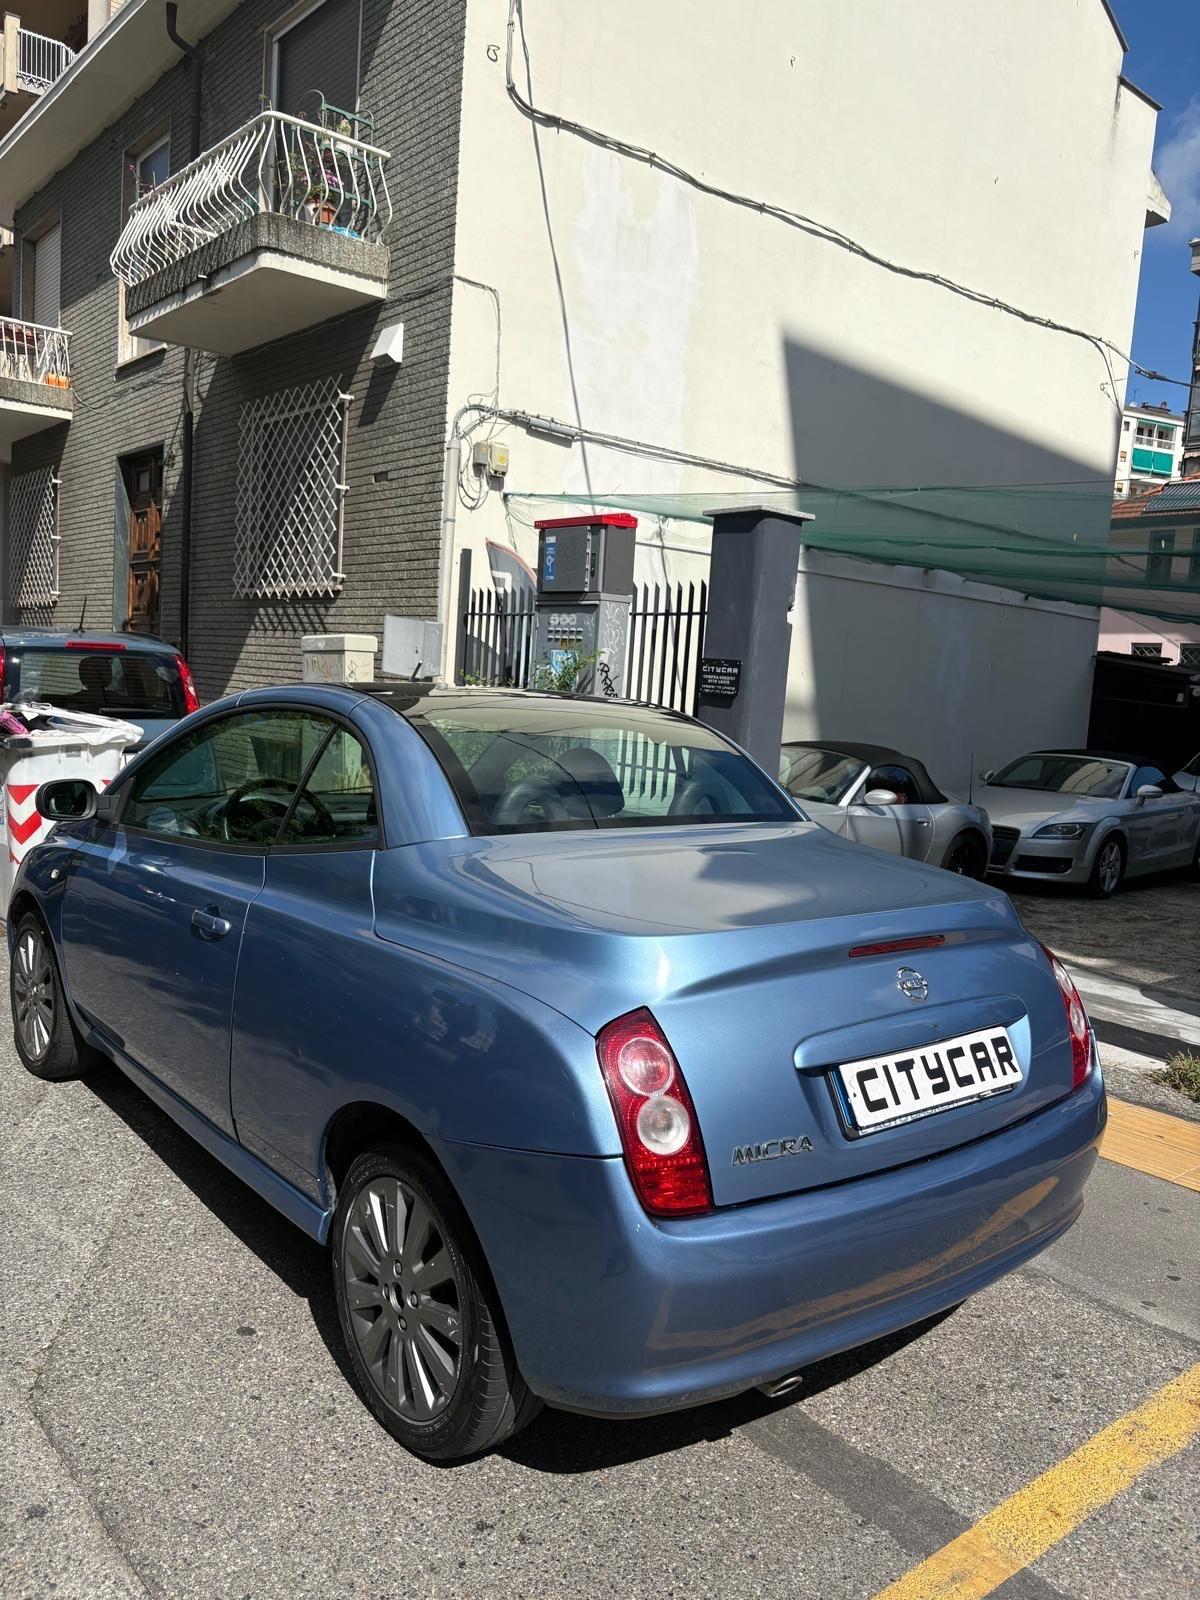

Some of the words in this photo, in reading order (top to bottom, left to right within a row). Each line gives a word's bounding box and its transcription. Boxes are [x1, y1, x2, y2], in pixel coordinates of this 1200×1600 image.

[702, 665, 738, 674] CITYCAR
[856, 1036, 1019, 1113] CITYCAR
[732, 1135, 813, 1168] MICRA
